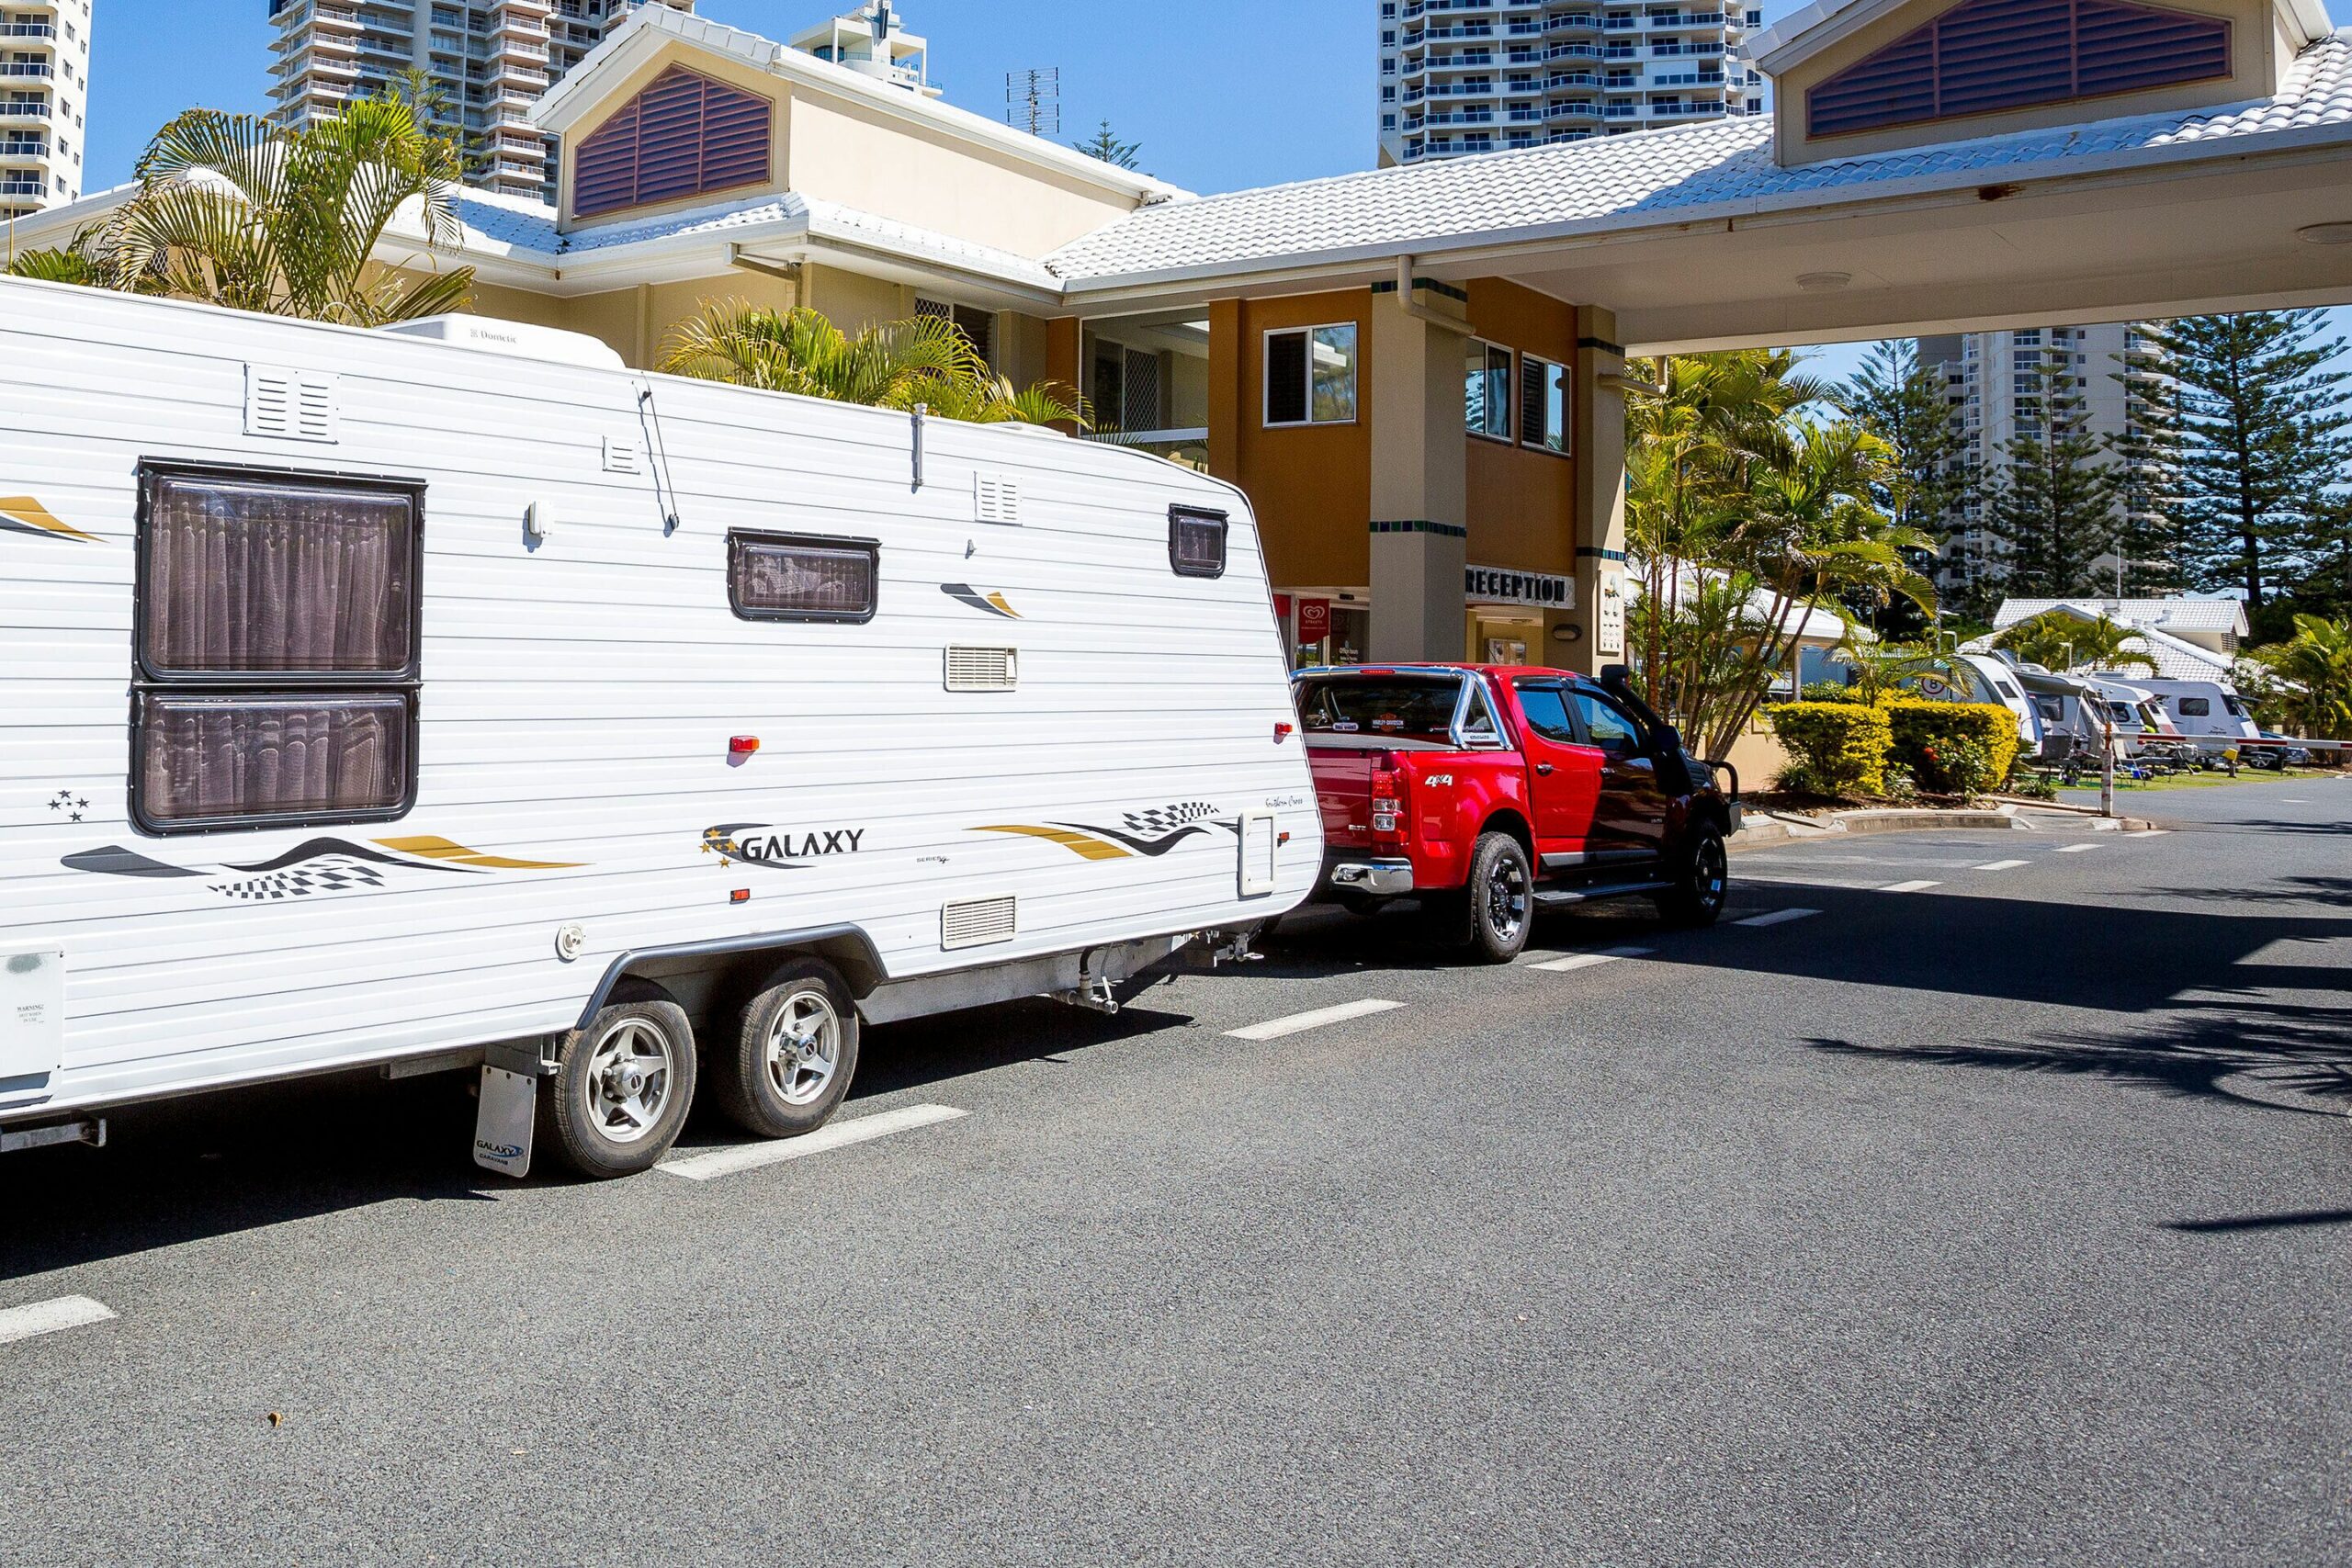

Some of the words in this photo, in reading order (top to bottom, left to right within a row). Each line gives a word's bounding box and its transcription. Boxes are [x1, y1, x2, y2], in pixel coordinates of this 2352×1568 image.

[481, 330, 517, 344] Dometic
[1465, 570, 1566, 602] RECEPTION
[741, 829, 865, 861] GALAXY
[477, 1139, 514, 1155] GALAXY
[479, 1153, 509, 1166] CARAVANS
